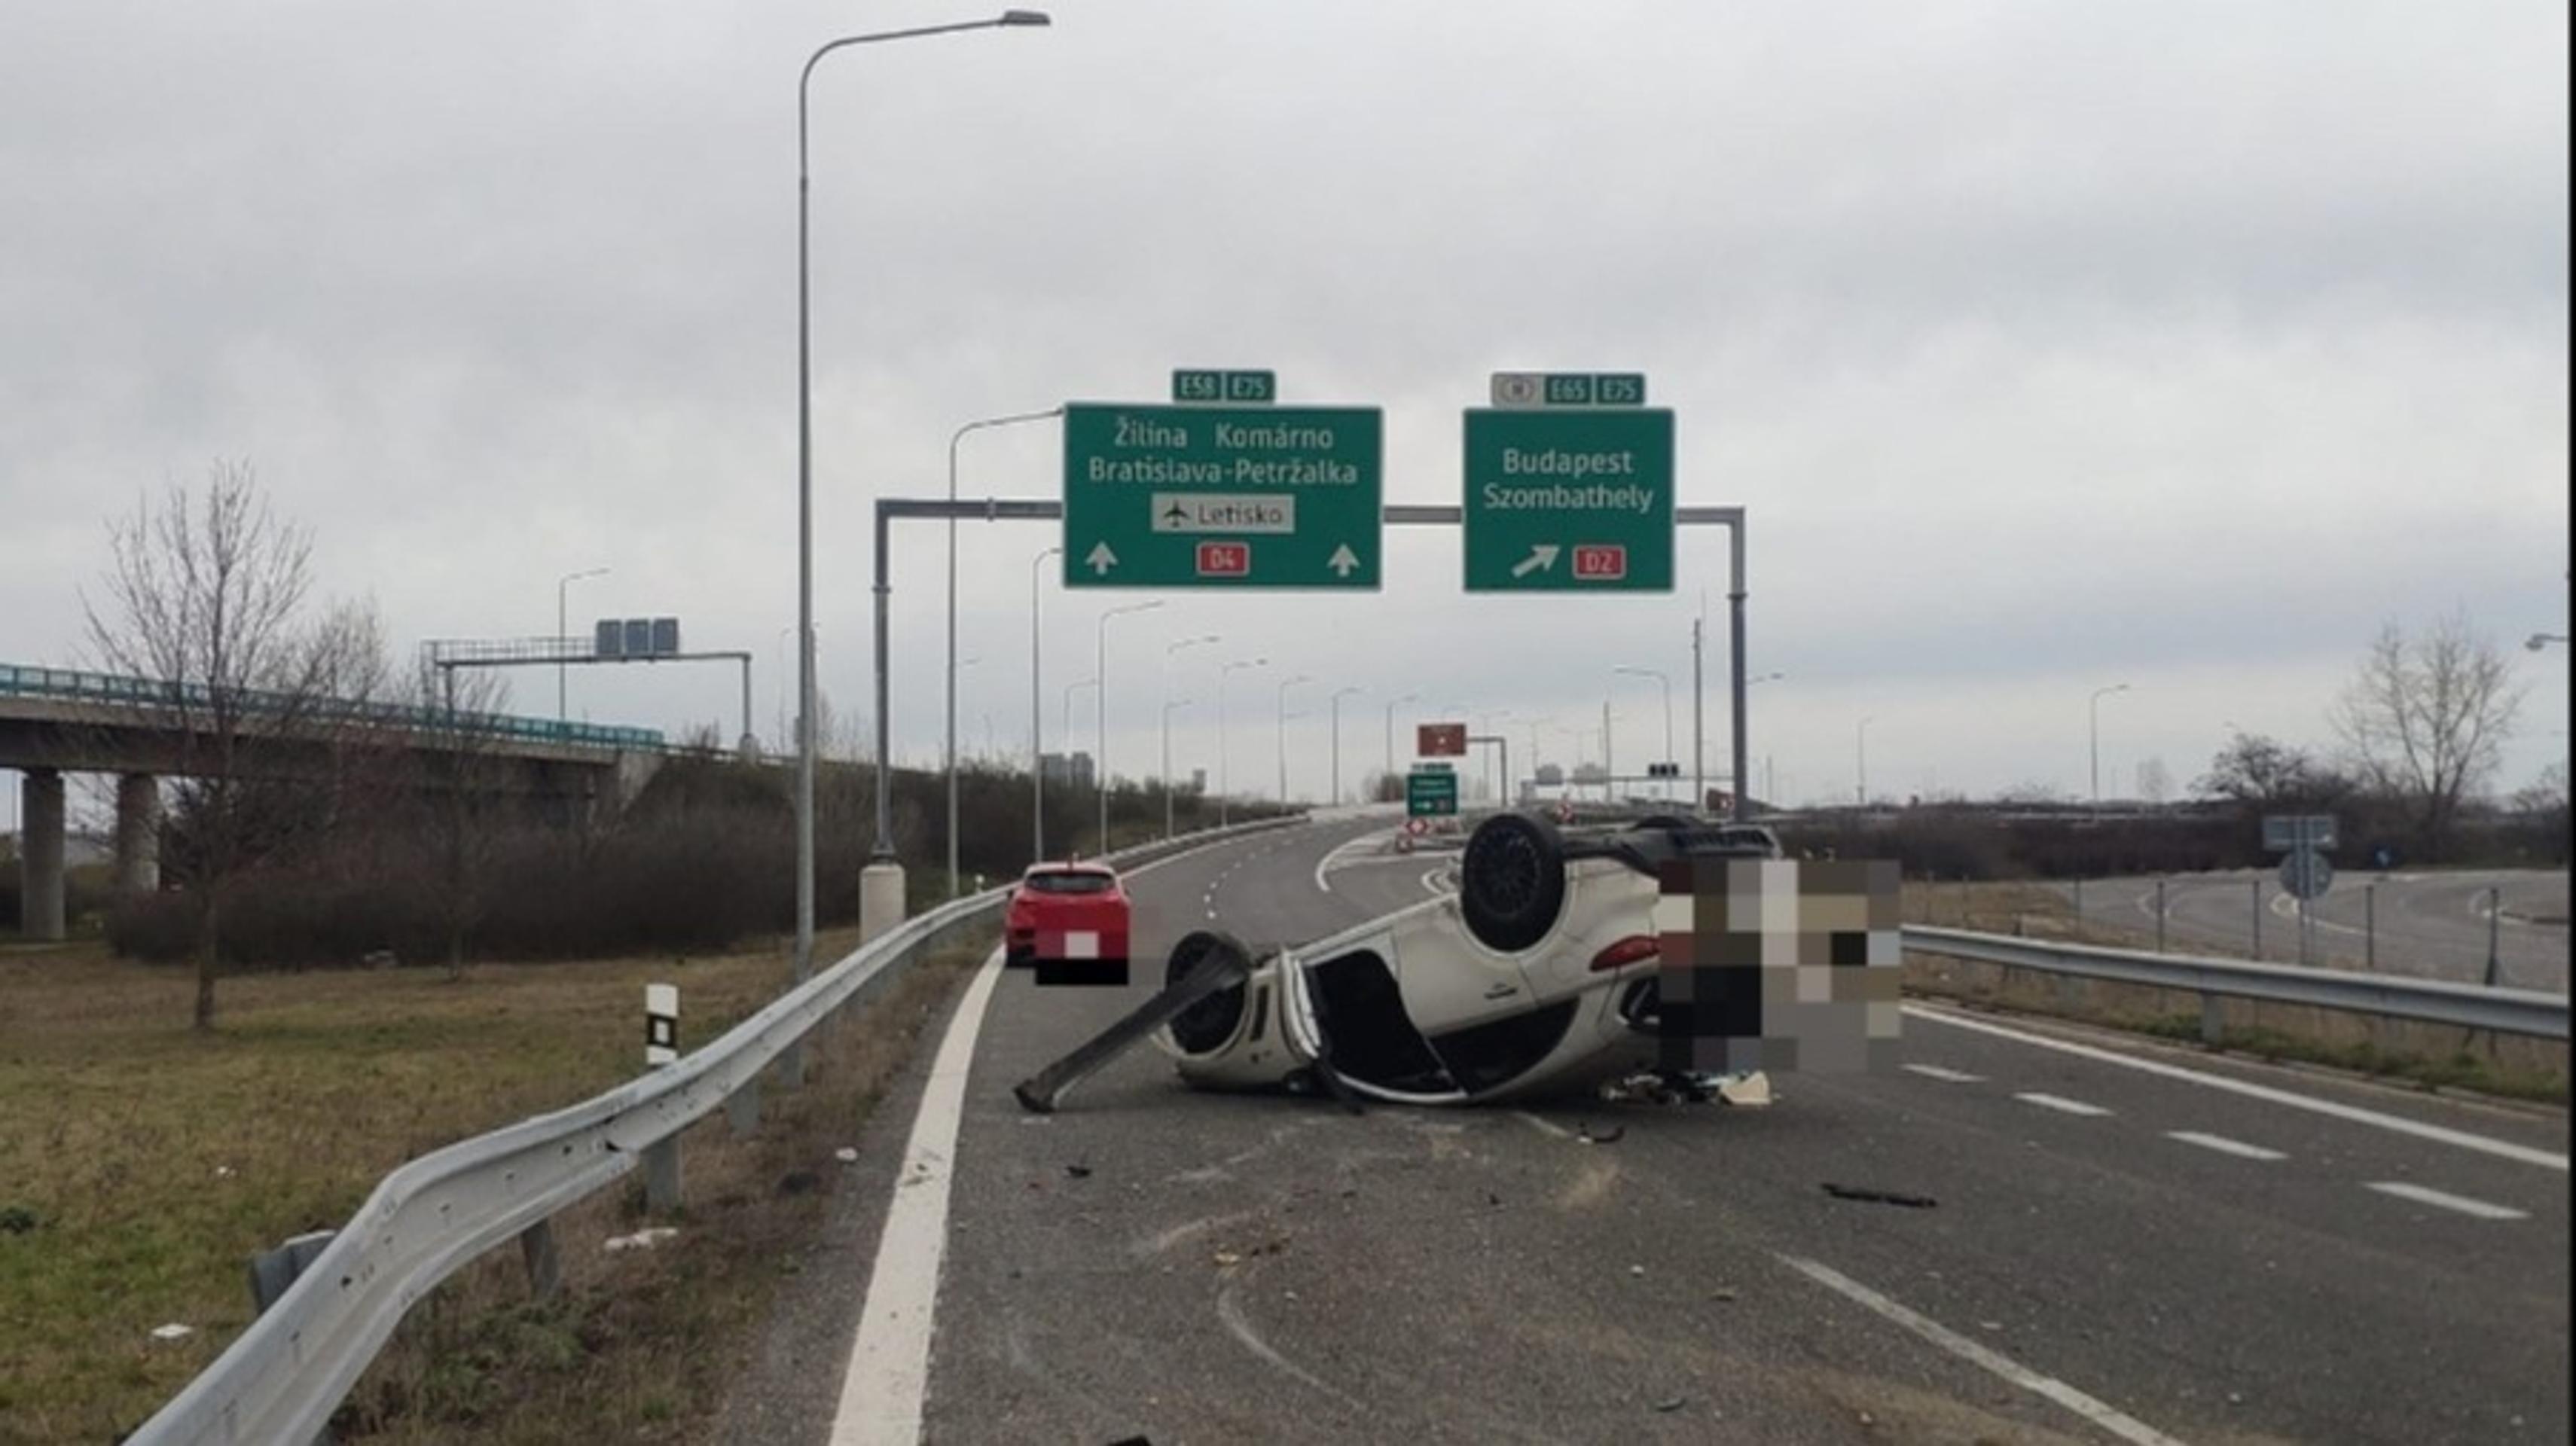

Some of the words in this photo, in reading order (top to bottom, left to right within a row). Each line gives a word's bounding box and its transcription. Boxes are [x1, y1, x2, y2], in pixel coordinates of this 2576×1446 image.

[1232, 376, 1267, 397] E75
[1551, 379, 1586, 400] E65
[1603, 379, 1636, 400] E75
[1114, 416, 1188, 448] Žilina
[1215, 422, 1334, 449] Komárno
[1089, 456, 1358, 484] Bratislava-Petržalka
[1503, 448, 1634, 478] Budapest
[1484, 483, 1654, 514] Szombathely
[1198, 503, 1283, 526] Letisko
[1210, 548, 1235, 569] D4
[1586, 552, 1613, 572] D2
